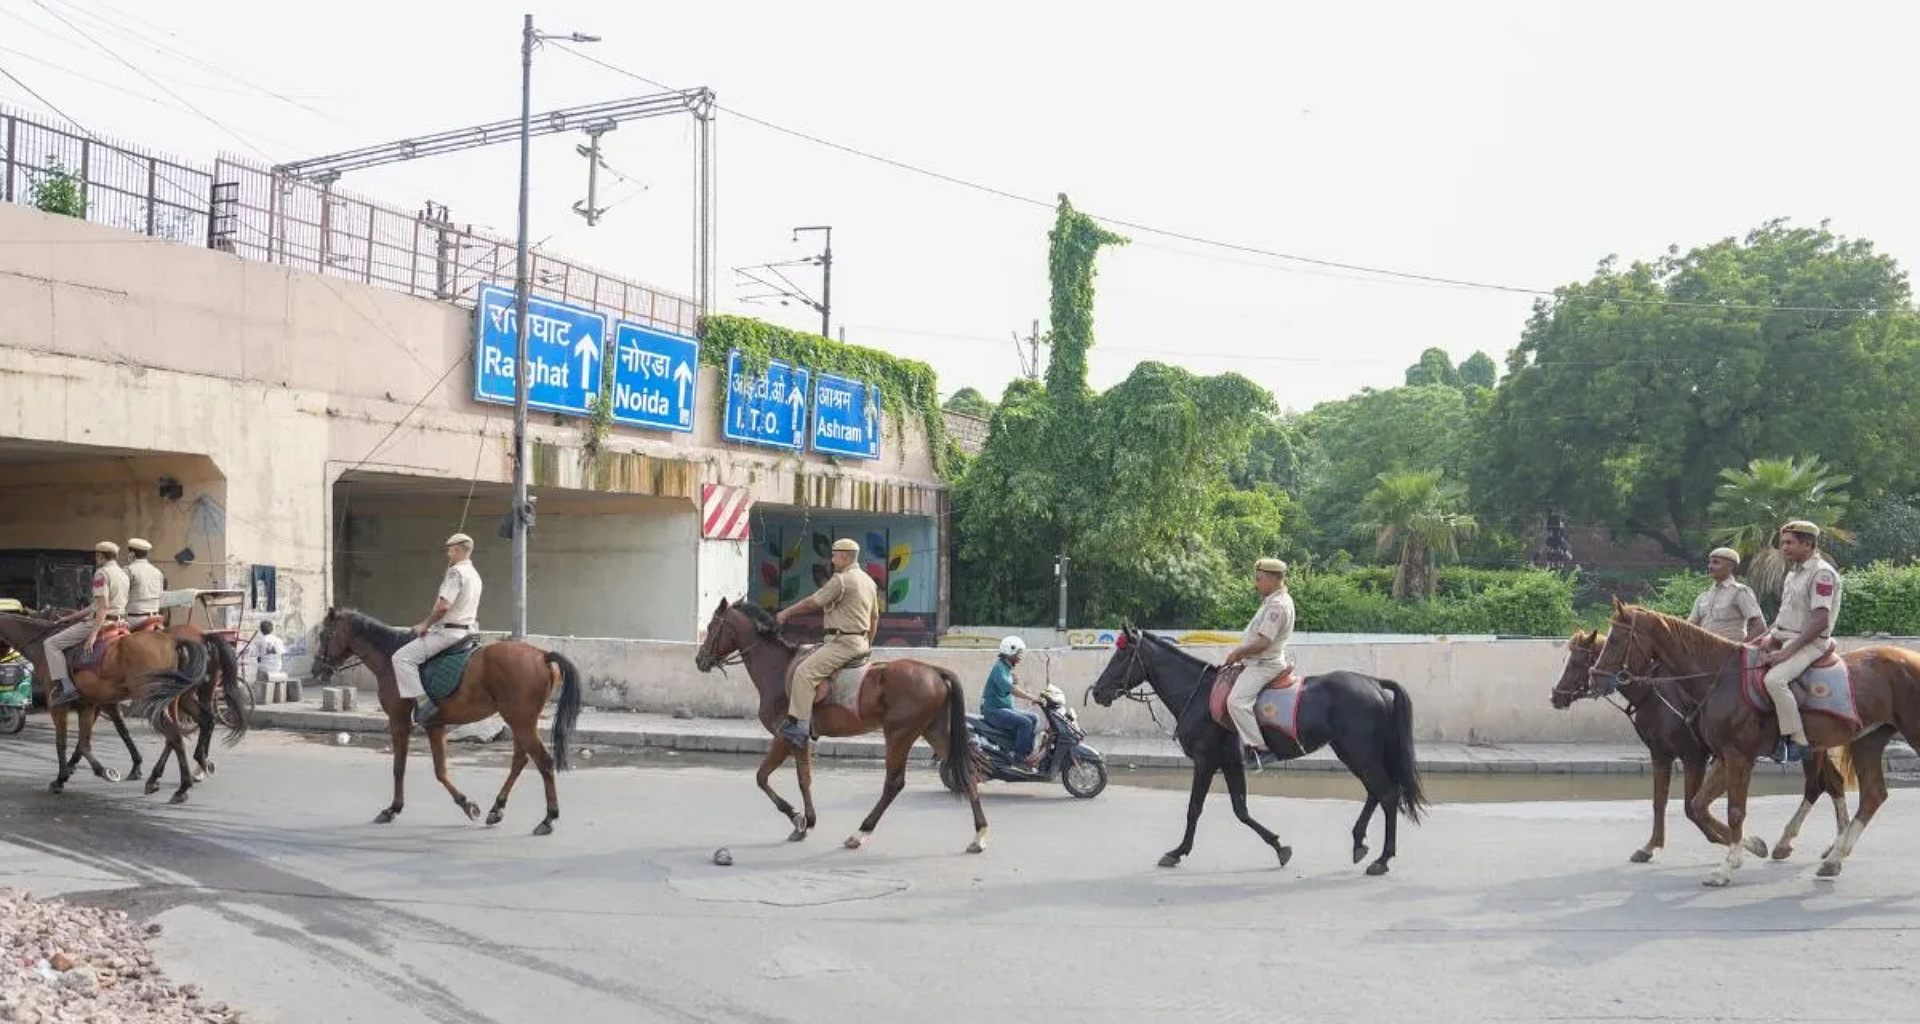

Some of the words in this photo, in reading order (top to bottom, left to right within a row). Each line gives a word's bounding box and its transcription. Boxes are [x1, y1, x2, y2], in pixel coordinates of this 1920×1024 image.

[485, 345, 569, 389] Raghat
[620, 338, 671, 380] नोएडा
[615, 382, 670, 416] Noida
[818, 387, 852, 413] आश्रम
[817, 416, 862, 443] Ashram
